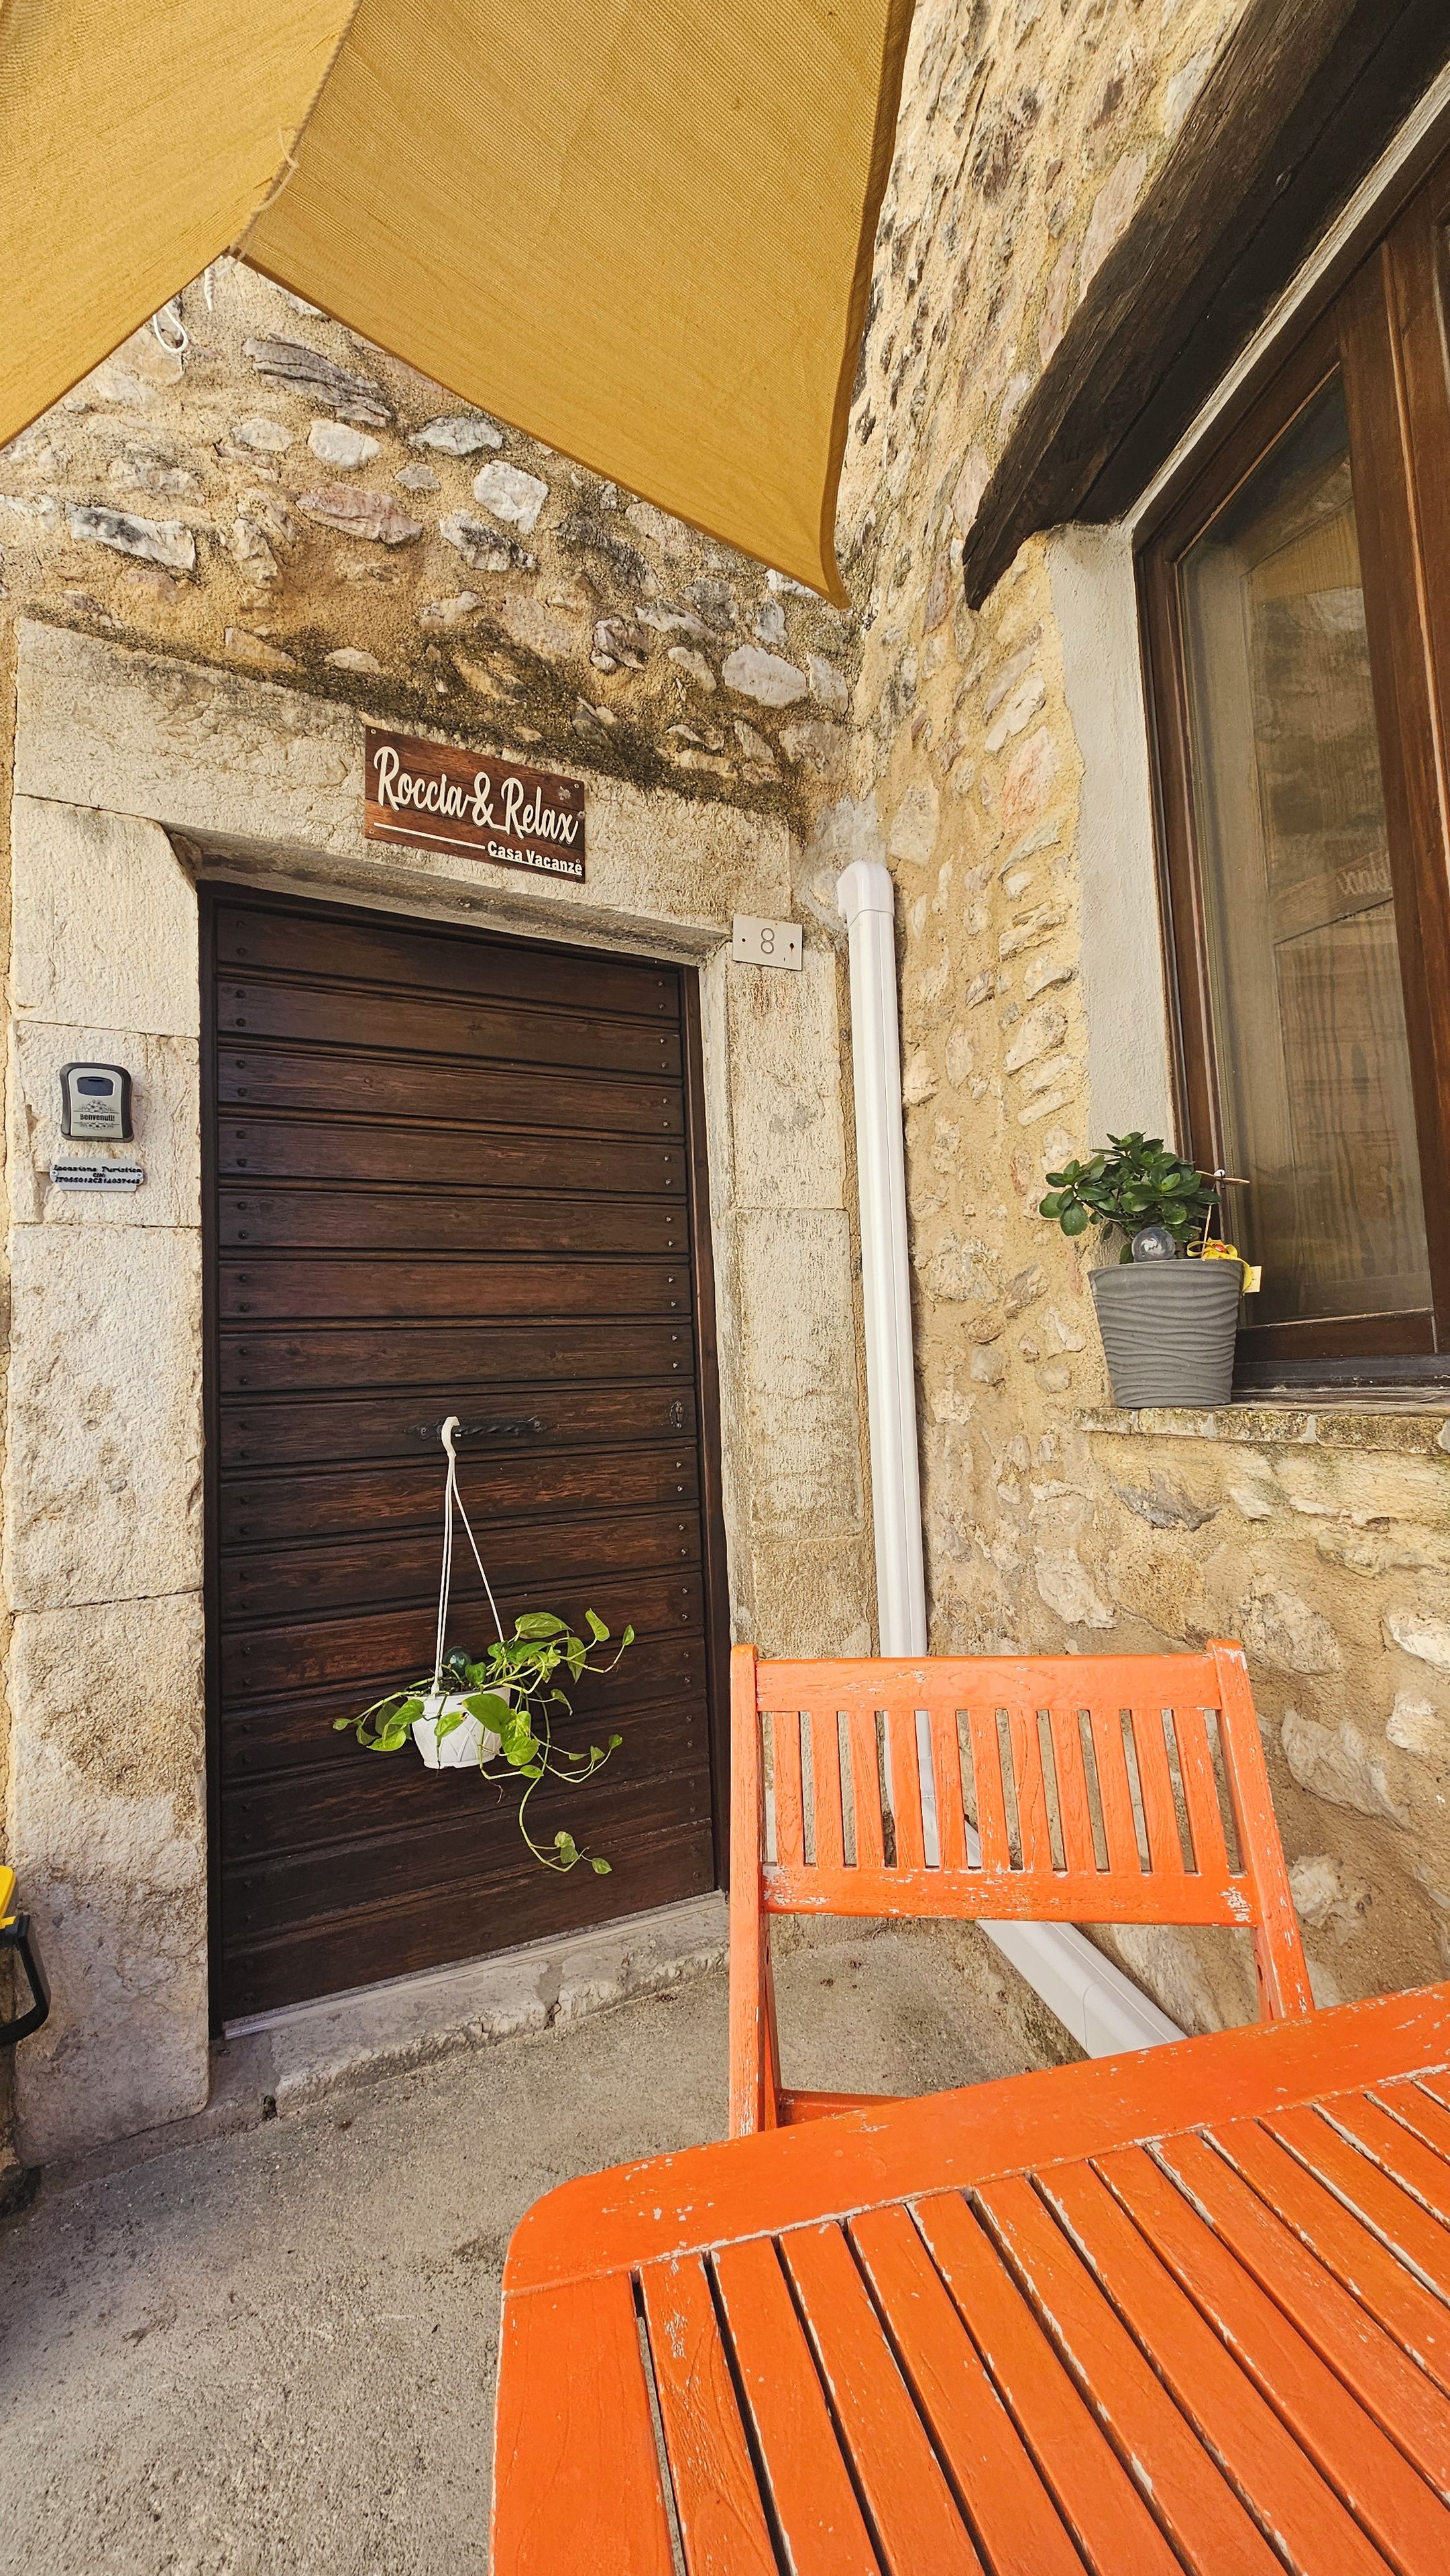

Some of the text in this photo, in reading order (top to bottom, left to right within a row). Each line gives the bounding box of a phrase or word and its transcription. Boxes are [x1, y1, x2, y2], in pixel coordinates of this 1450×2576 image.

[488, 841, 583, 875] Casa Vacanze
[761, 927, 775, 954] 8
[80, 1114, 115, 1122] Benvenuti!
[54, 1164, 97, 1173] Locazione
